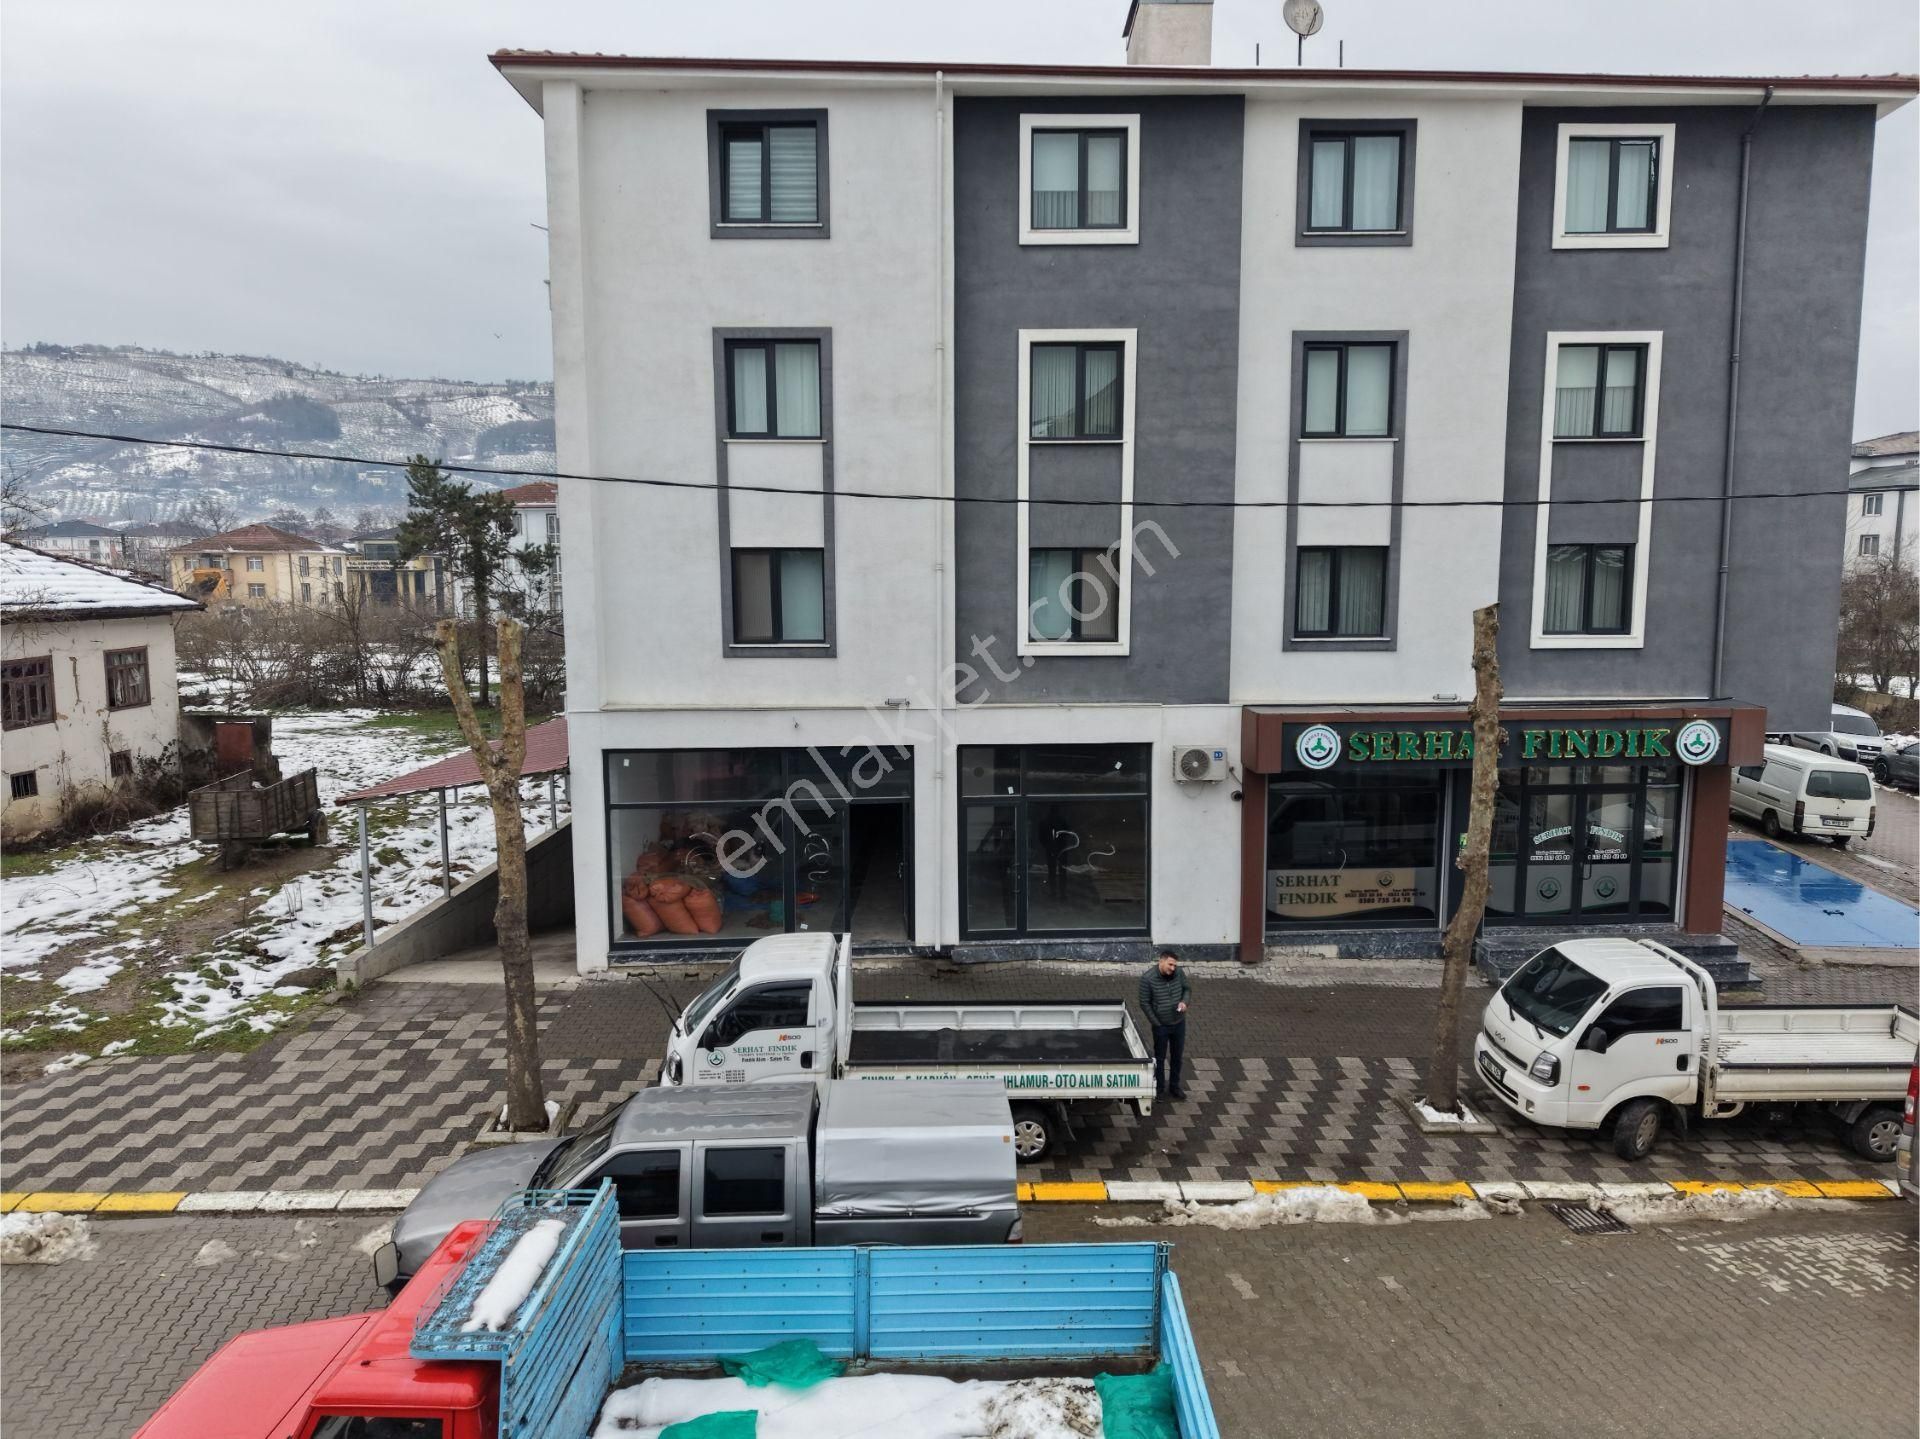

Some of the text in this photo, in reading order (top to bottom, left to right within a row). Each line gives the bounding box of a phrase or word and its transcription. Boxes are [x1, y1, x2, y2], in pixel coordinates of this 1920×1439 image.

[1349, 729, 1670, 761] SERHA FINDIK
[1275, 875, 1341, 887] SERHAT
[1278, 892, 1338, 905] FINDIK
[732, 1046, 764, 1054] SERHAT
[1079, 1073, 1103, 1088] ALIM
[1106, 1073, 1140, 1088] SATIMI
